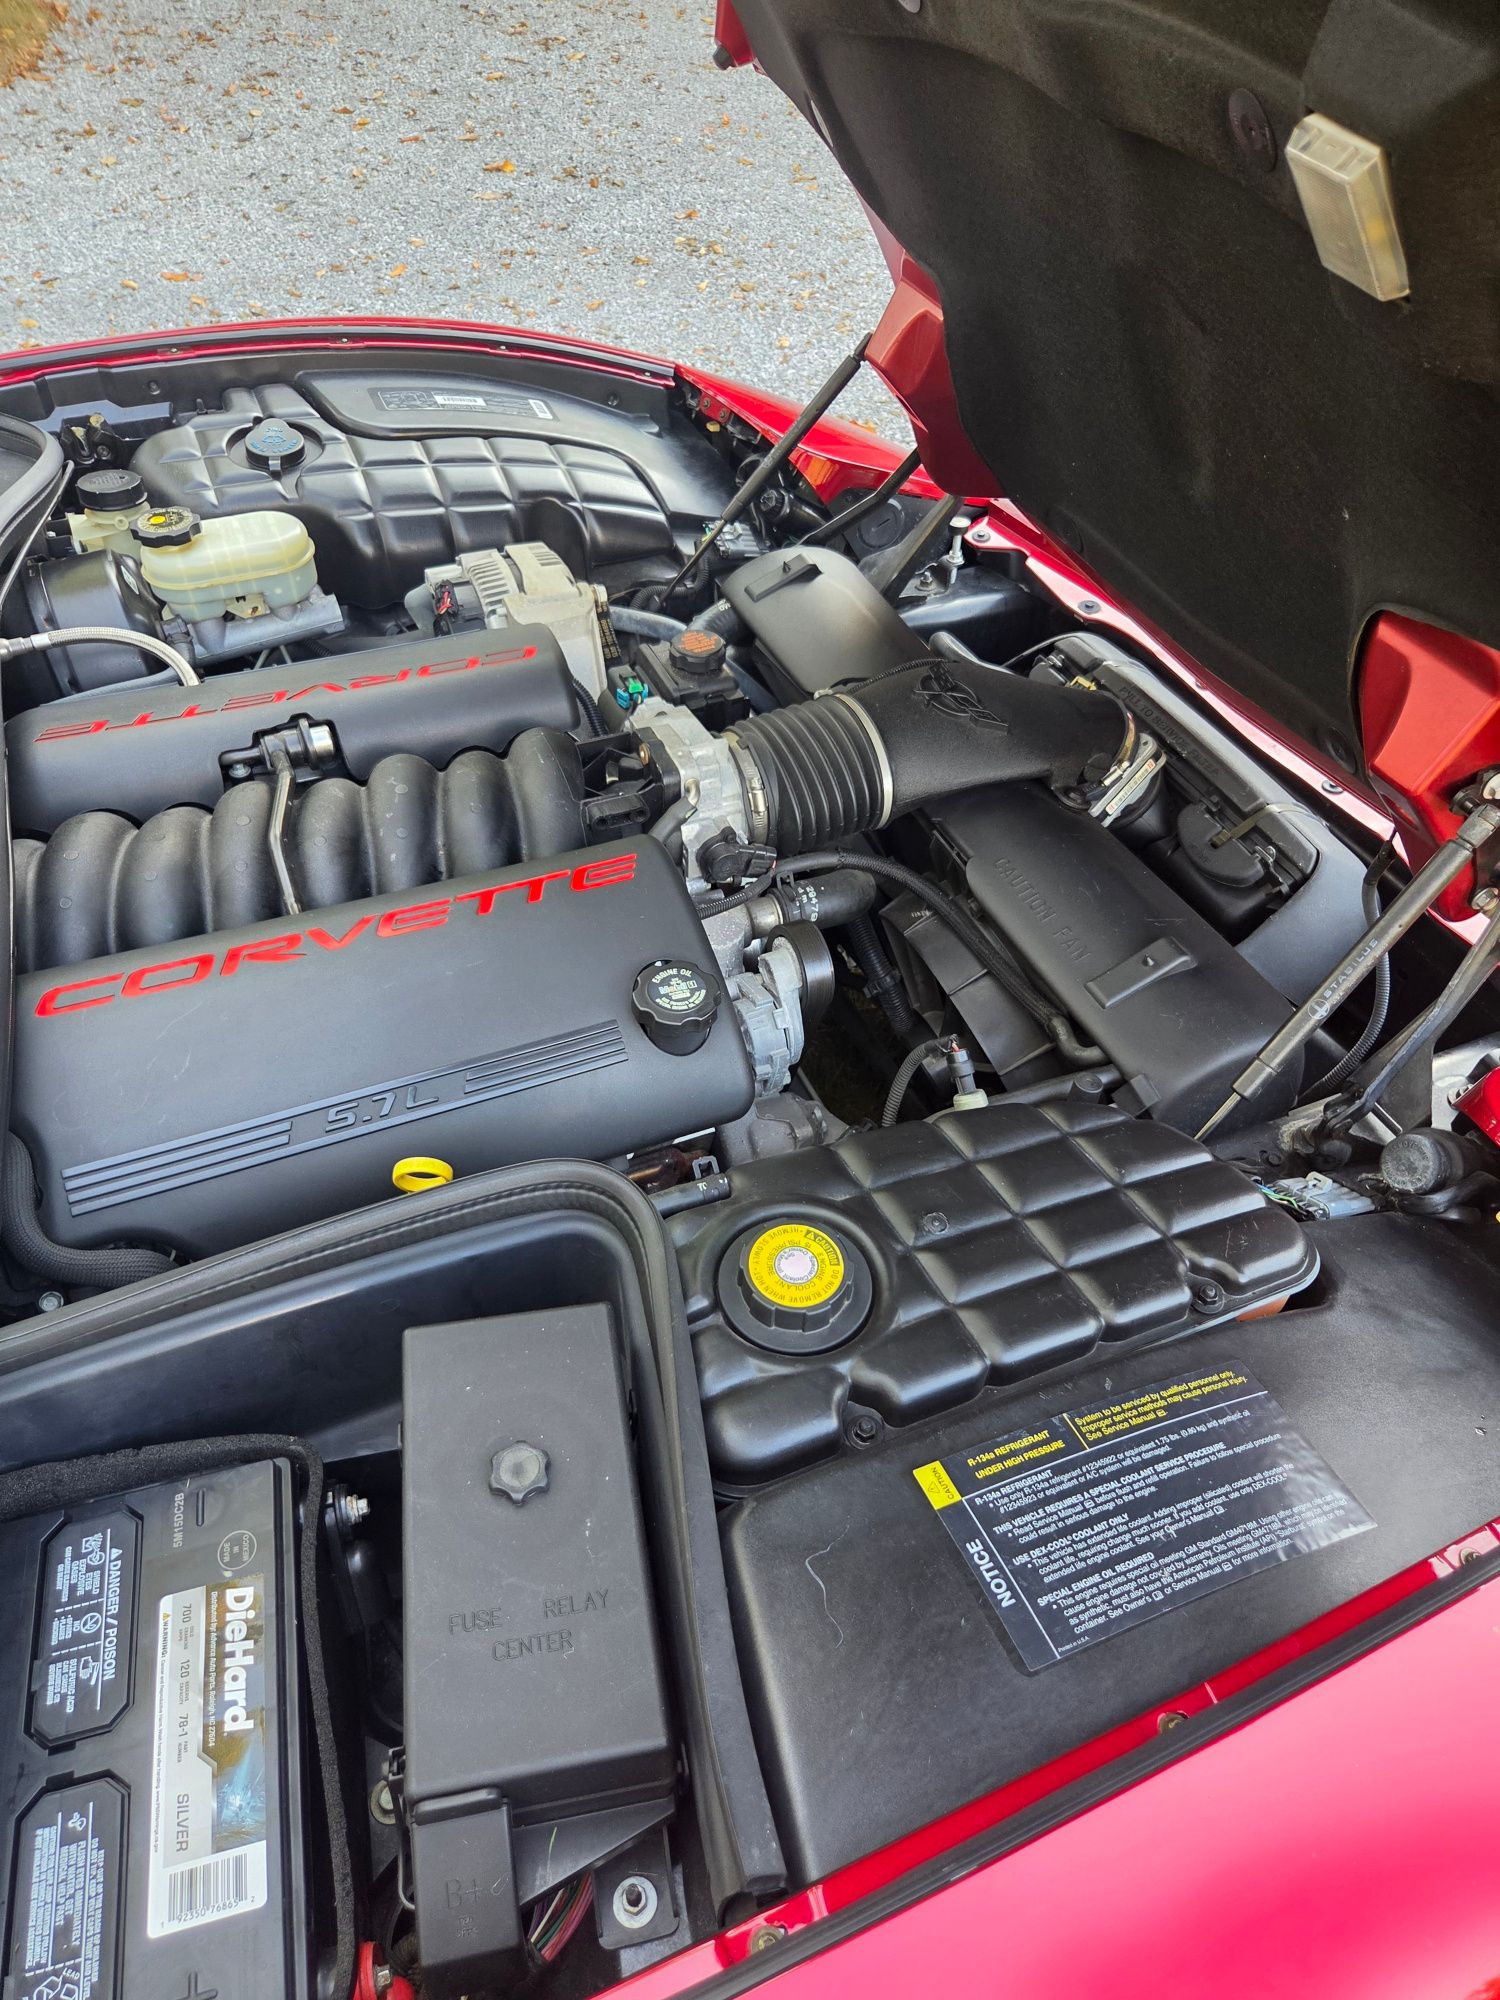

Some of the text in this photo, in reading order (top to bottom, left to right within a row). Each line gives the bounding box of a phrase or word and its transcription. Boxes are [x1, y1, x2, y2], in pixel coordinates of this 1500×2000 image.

[34, 645, 537, 743] CORVETTE
[995, 858, 1057, 923] CAUTION
[35, 853, 637, 1018] CORVETTE
[652, 968, 692, 983] ENGINE OIL
[1322, 937, 1379, 998] STABILUS
[325, 1086, 438, 1132] 5.7L
[816, 1236, 840, 1266] CAUTION
[763, 1286, 786, 1301] WHEN
[774, 1278, 816, 1292] COOLANT
[822, 1280, 834, 1293] NOT
[831, 1269, 840, 1280] DO
[789, 1292, 821, 1304] REMOVE
[1073, 1410, 1104, 1426] System
[1109, 1404, 1122, 1413] be
[1120, 1394, 1151, 1409] serviced
[1149, 1391, 1162, 1401] by
[1158, 1383, 1190, 1398] qualified
[1186, 1374, 1221, 1389] personnel
[1218, 1369, 1236, 1380] only.
[1079, 1374, 1248, 1434] Improper service methods may cause personal injury.
[1084, 1411, 1156, 1440] See Service Manual
[966, 1430, 1051, 1466] R-134a REFRIGERANT
[974, 1439, 1065, 1478] UNDER HIGH PRESSURE
[930, 1467, 955, 1500] CAUTION
[974, 1469, 1054, 1504] R-134a REFRIGERANT
[992, 1521, 1013, 1534] THIS
[1011, 1508, 1046, 1526] VEHICLE
[1044, 1493, 1084, 1513] REQUIRES
[1088, 1479, 1121, 1496] SPECIAL
[1119, 1467, 1156, 1484] COOLANT
[1153, 1456, 1186, 1472] SERVICE
[1183, 1441, 1226, 1461] PROCEDURE
[993, 1495, 1010, 1506] Use
[1008, 1490, 1025, 1501] only
[1023, 1480, 1049, 1494] R-134a
[1048, 1468, 1083, 1486] refrigerant
[1123, 1441, 1157, 1458] equivalent
[1154, 1436, 1170, 1446] 1.75
[1043, 1478, 1080, 1497] equivalent
[1084, 1470, 1099, 1479] A/C
[1097, 1461, 1123, 1476] system
[1120, 1458, 1133, 1466] will
[1140, 1444, 1173, 1460] damaged.
[232, 1545, 238, 1553] IN
[1011, 1553, 1031, 1565] USE
[1071, 1521, 1109, 1541] COOLANT
[1107, 1512, 1130, 1526] ONLY
[105, 1559, 121, 1614] DANGER
[965, 1539, 1016, 1607] NOTICE
[1036, 1551, 1155, 1606] SPECIAL ENGINE OIL REQUIRED
[1072, 1613, 1108, 1633] container.
[1106, 1606, 1124, 1618] See
[1121, 1594, 1152, 1612] Owner's
[1170, 1575, 1198, 1590] Service
[1195, 1565, 1222, 1580] Manual
[1230, 1556, 1243, 1565] for
[1241, 1551, 1259, 1561] more
[1256, 1535, 1294, 1555] information.
[182, 1603, 191, 1622] 700
[449, 1588, 609, 1634] FUSE RELAY
[102, 1628, 117, 1680] POISON
[223, 1586, 254, 1732] DieHard
[491, 1629, 573, 1662] CENTER
[180, 1659, 189, 1678] 120
[66, 1694, 74, 1712] ACID
[208, 1715, 215, 1724] NC
[177, 1713, 188, 1737] 78-1
[175, 1793, 188, 1852] SILVER
[62, 1968, 80, 1980] LEAD
